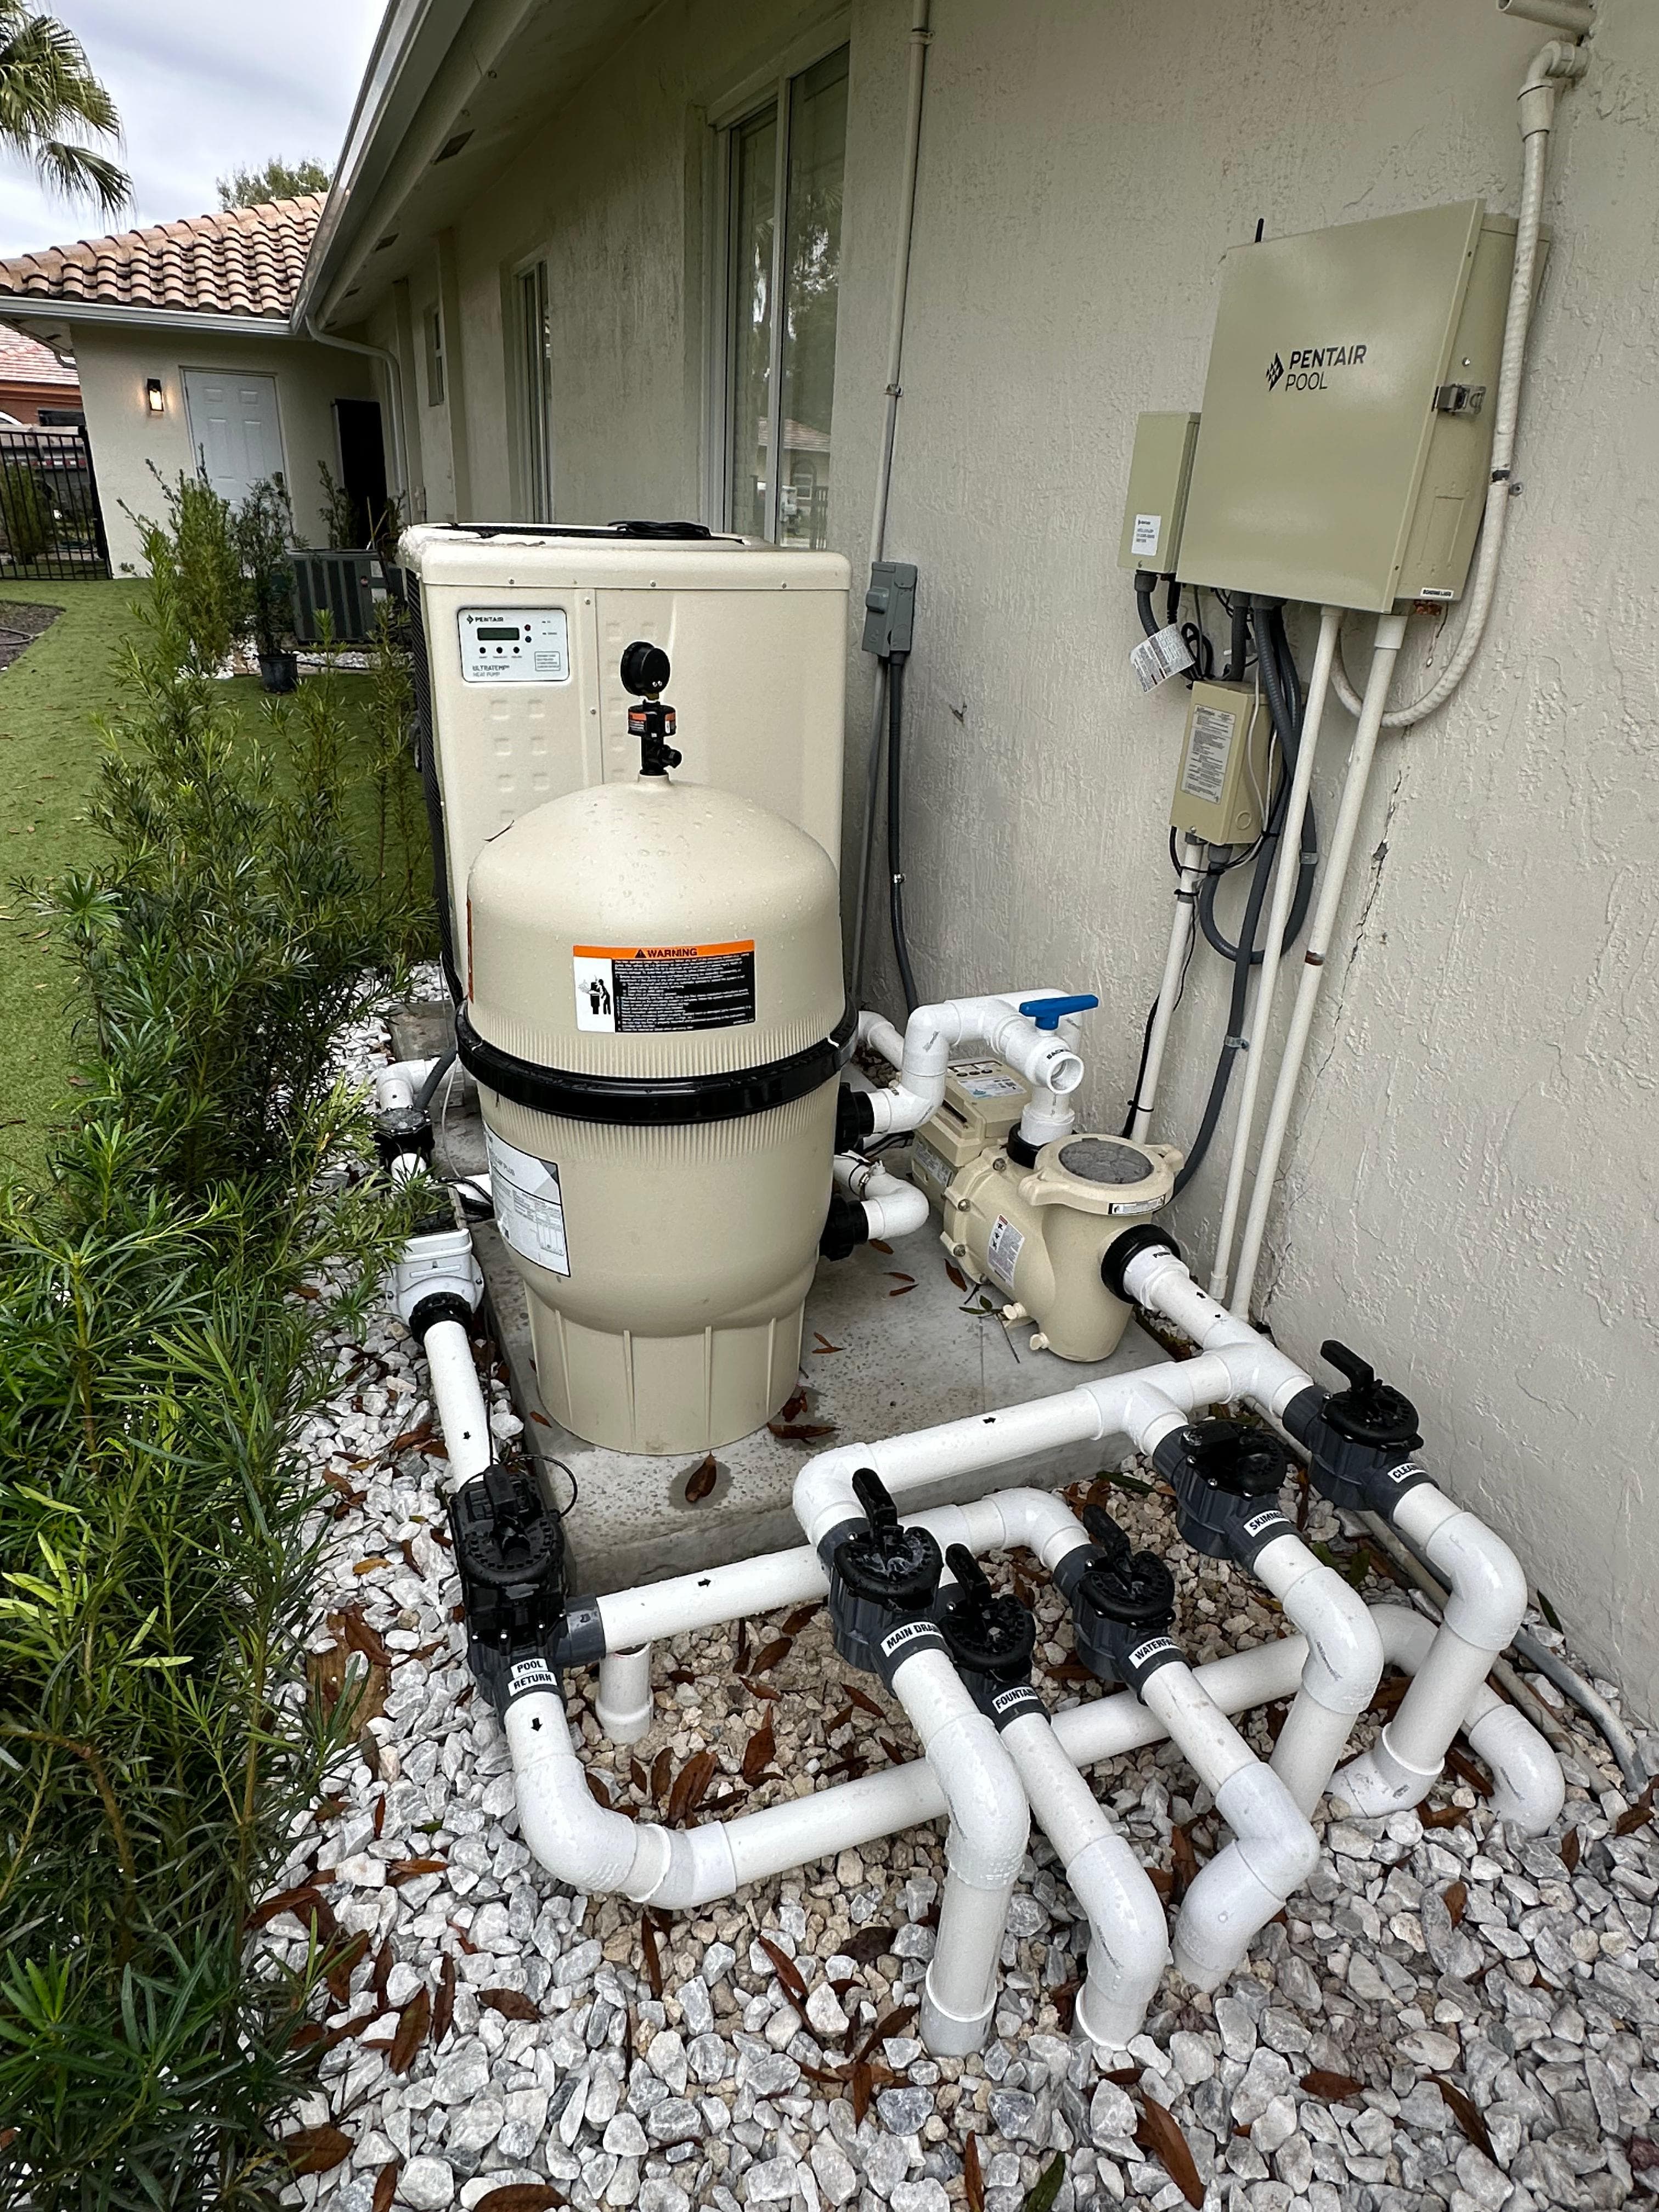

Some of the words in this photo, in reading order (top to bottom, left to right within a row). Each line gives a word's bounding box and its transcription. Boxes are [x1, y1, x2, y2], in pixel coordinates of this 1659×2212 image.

[1289, 345, 1367, 369] PENTAIR
[1285, 371, 1328, 392] POOL
[647, 948, 698, 958] WARNING
[1249, 1512, 1285, 1530] SKIMM
[887, 1627, 913, 1649] MAIN
[1135, 1639, 1174, 1660] WATERFA
[517, 1661, 543, 1673] POOL
[514, 1673, 552, 1690] RETURN
